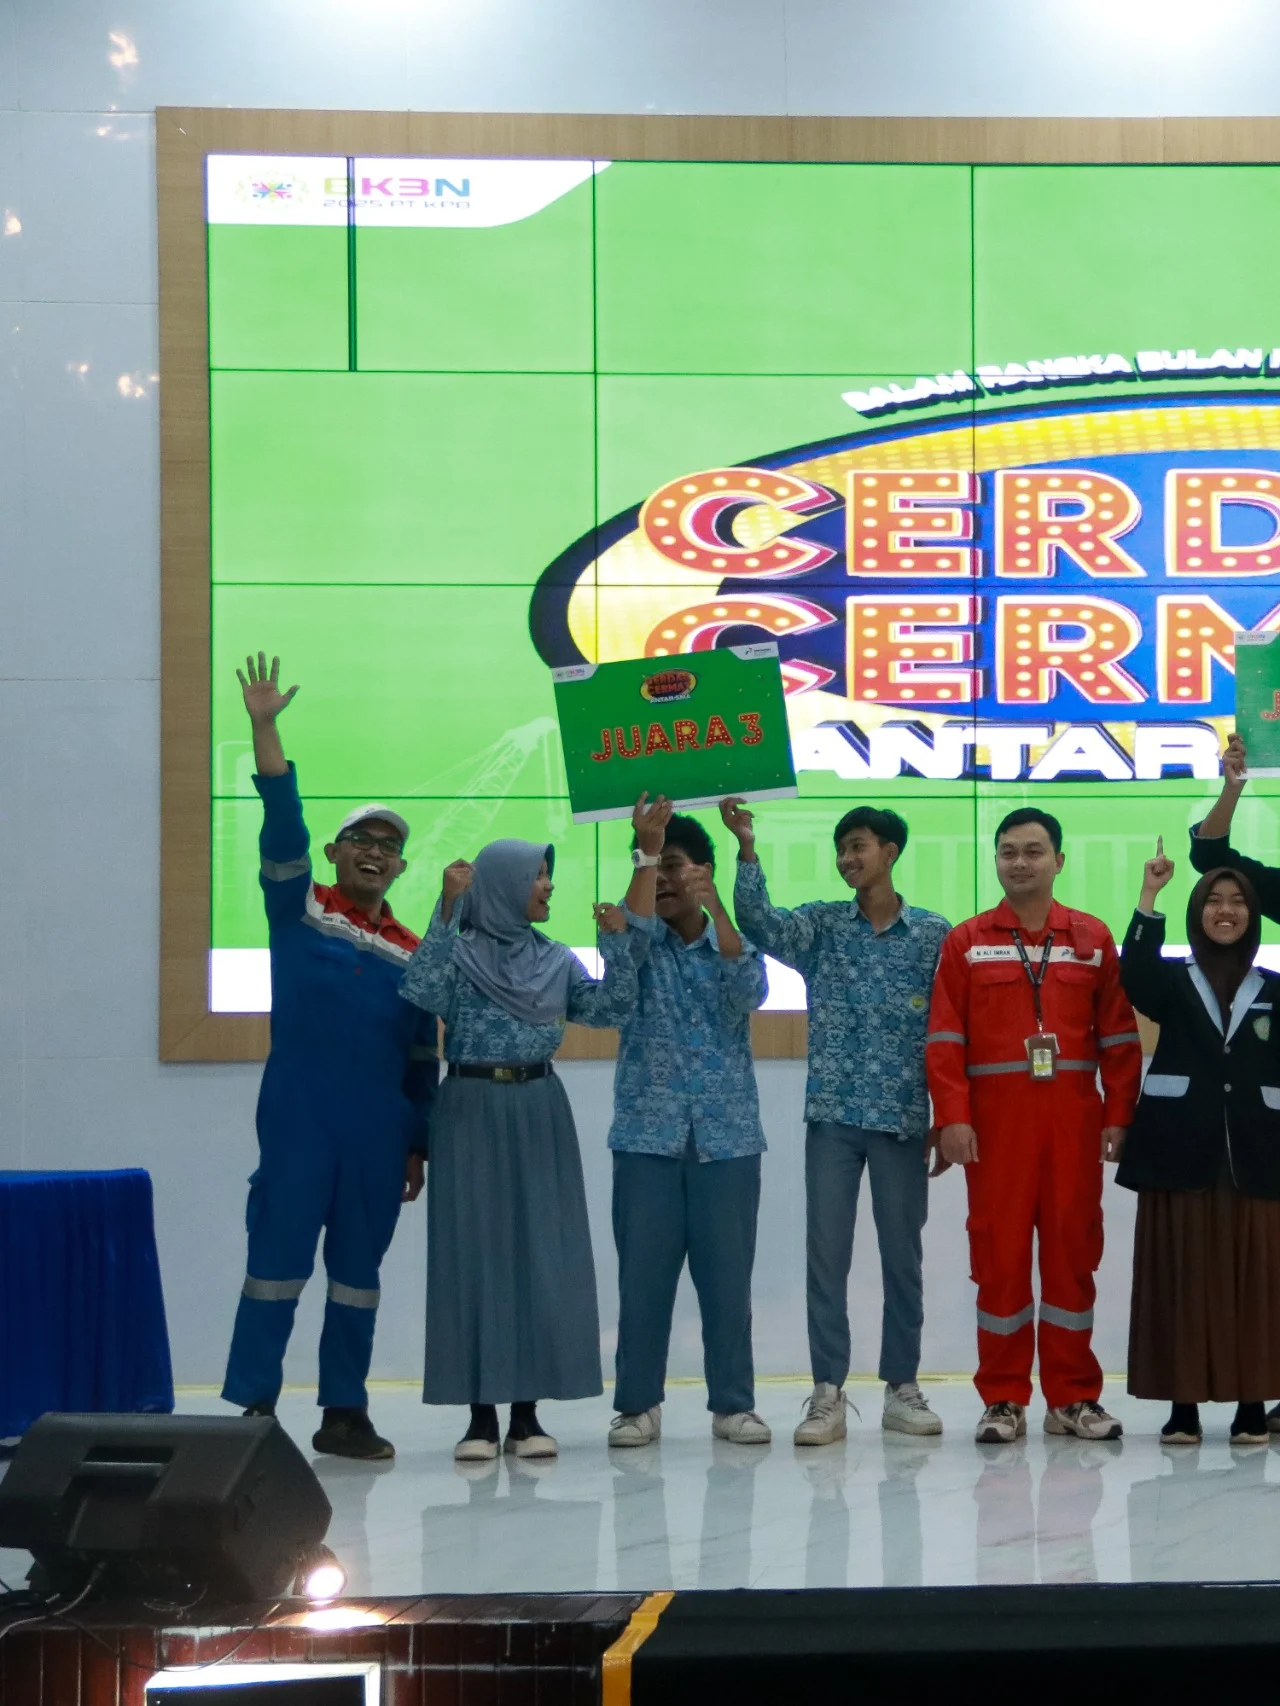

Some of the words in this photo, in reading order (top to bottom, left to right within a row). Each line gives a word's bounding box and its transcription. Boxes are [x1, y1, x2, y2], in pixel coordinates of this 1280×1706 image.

[1135, 347, 1264, 377] BULAN
[591, 714, 735, 763] JUARA
[738, 712, 764, 746] 3
